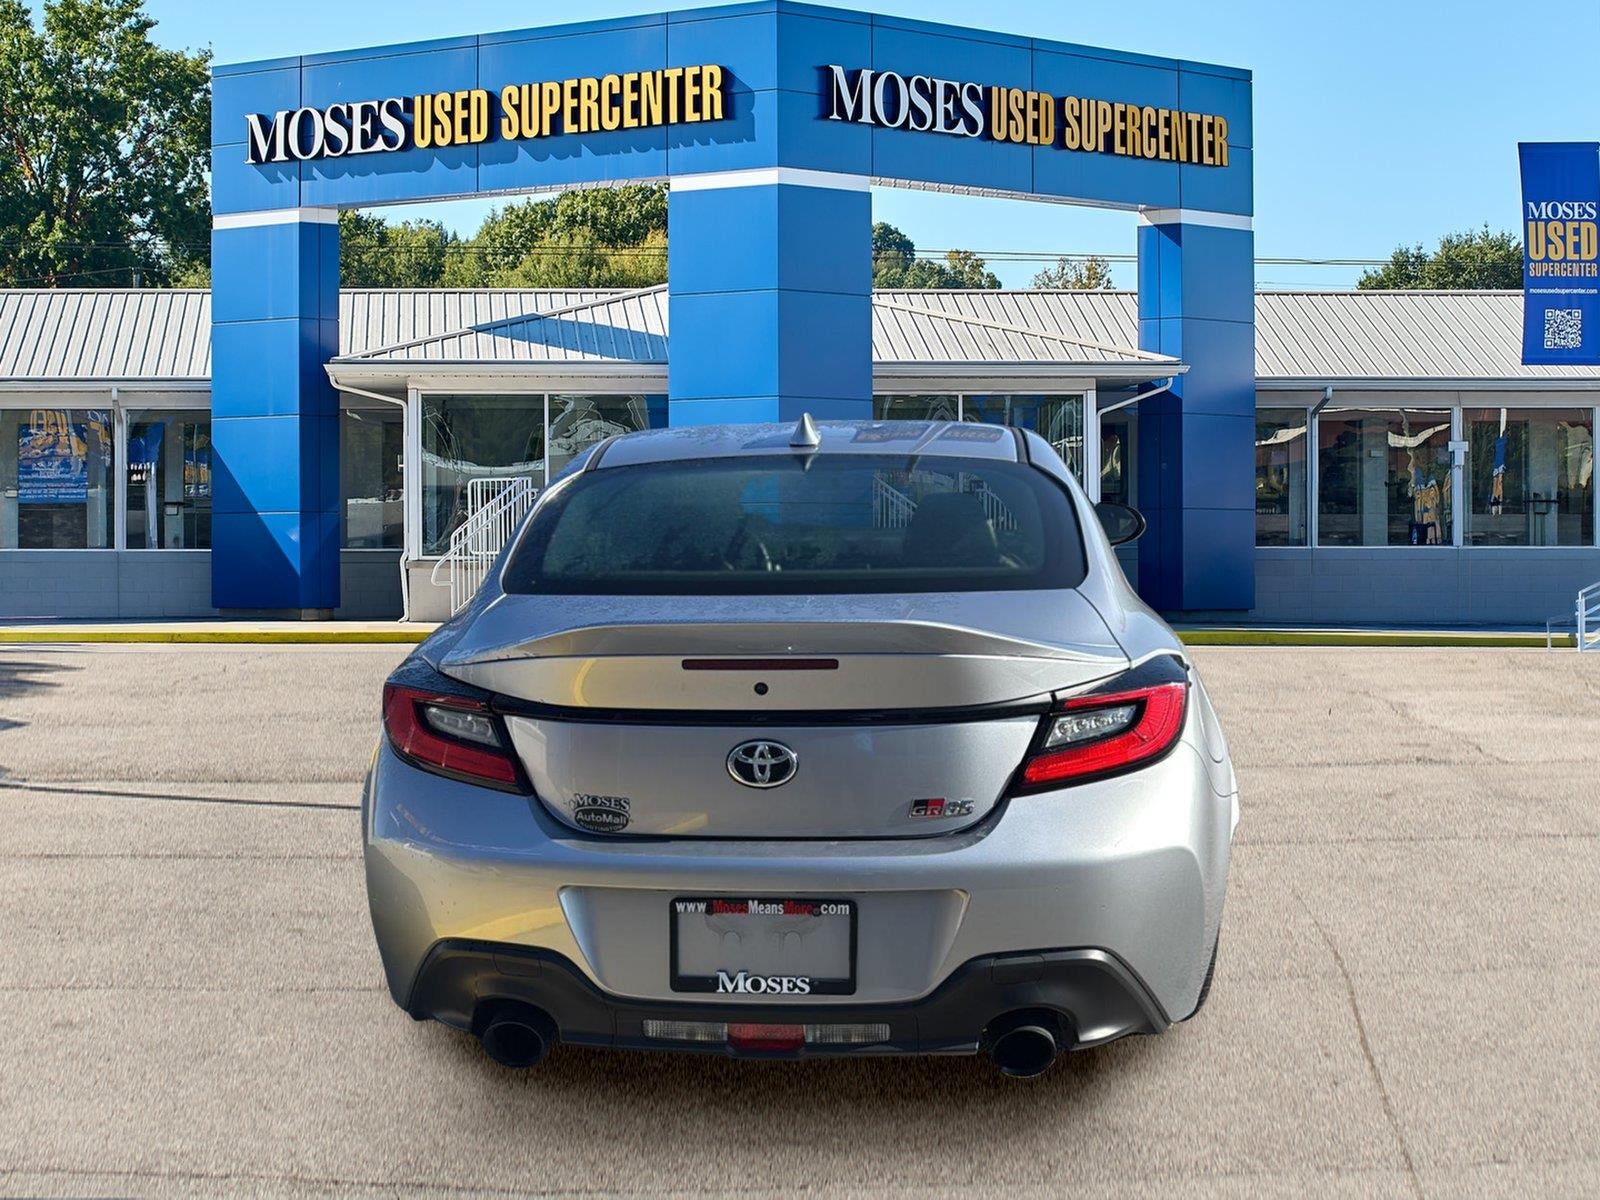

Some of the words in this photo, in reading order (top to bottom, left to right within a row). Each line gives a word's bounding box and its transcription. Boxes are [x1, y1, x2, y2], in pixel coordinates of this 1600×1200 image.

[244, 97, 407, 165] MOSES
[413, 89, 489, 148] USED
[500, 64, 724, 141] SUPERCENTER
[828, 64, 984, 138] MOSES
[991, 86, 1056, 146] USED
[1064, 96, 1230, 167] SUPERCENTER
[1527, 201, 1597, 220] MOSES
[1528, 221, 1598, 261] USED
[1529, 262, 1598, 277] SUPERCENTER
[1529, 287, 1598, 295] mosesusedsupercenter.com
[575, 793, 630, 811] MOSES
[576, 811, 627, 824] AutoMall
[716, 971, 811, 994] MOSES
